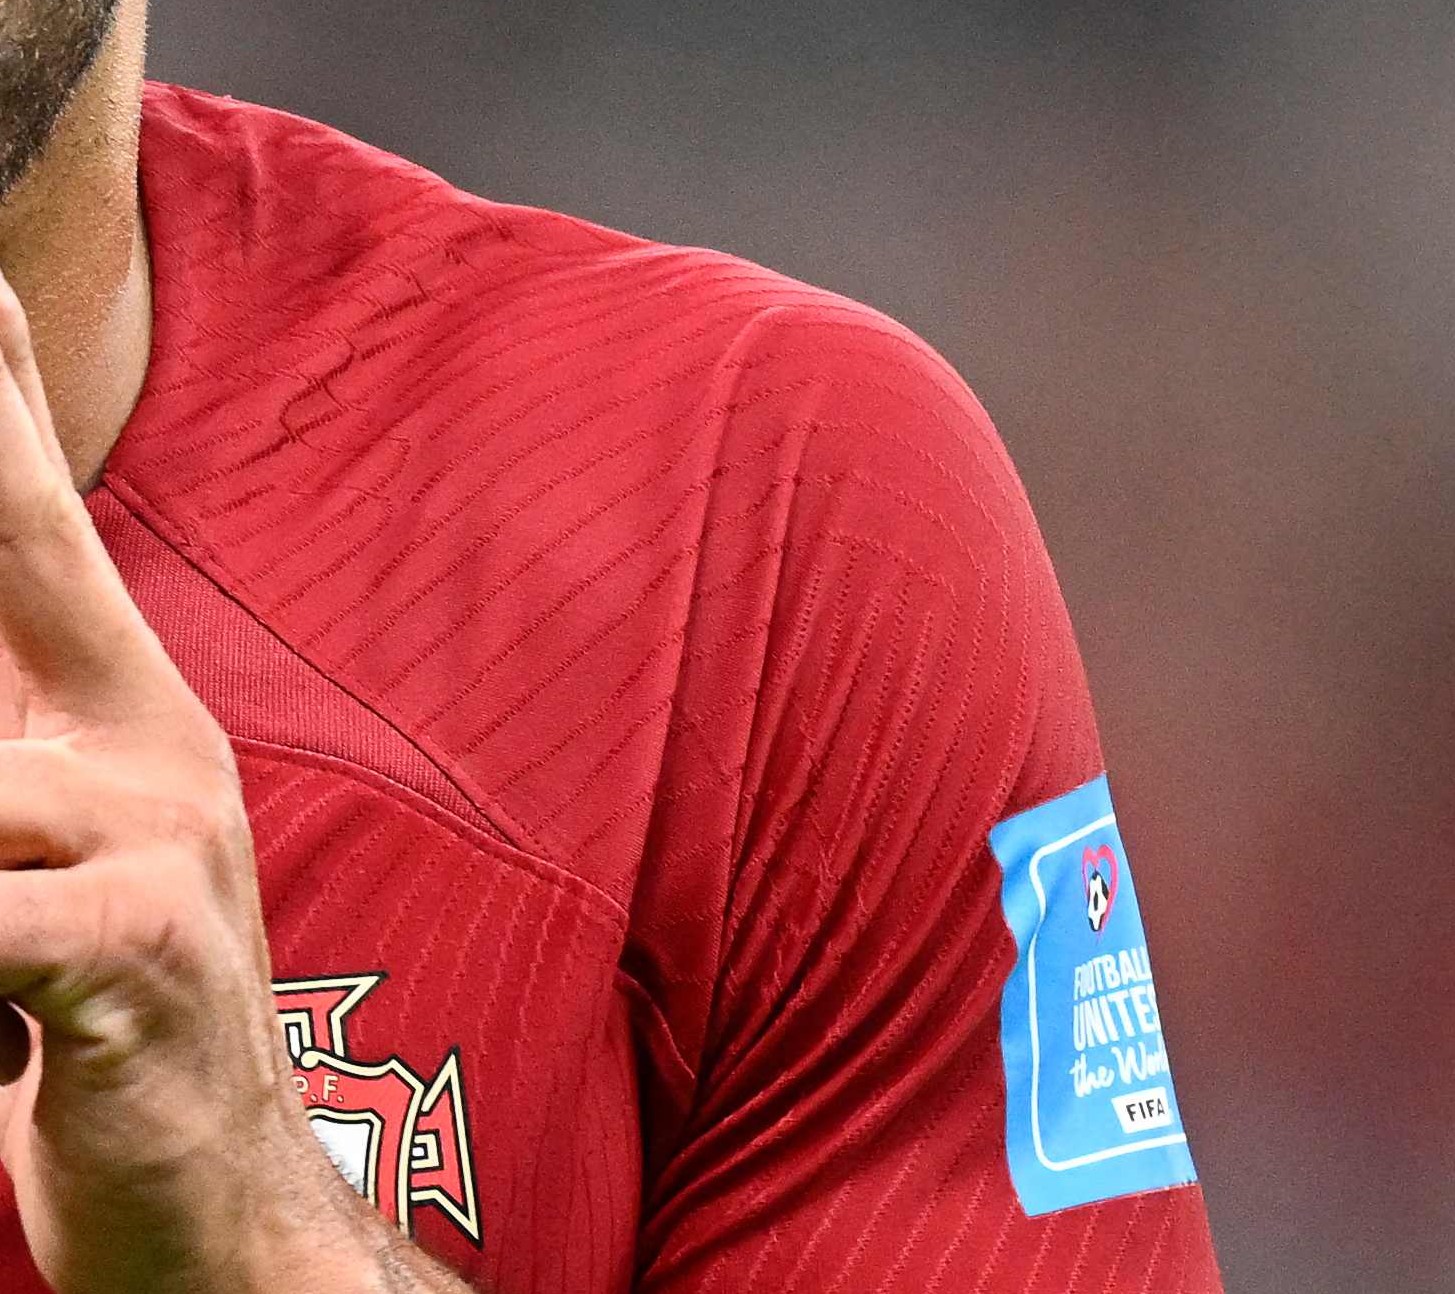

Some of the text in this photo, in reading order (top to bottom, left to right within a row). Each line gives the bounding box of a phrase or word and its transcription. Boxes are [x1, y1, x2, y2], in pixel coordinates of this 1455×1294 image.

[289, 1074, 345, 1103] P.F.
[1070, 1053, 1115, 1098] the
[1126, 1097, 1165, 1122] FIFA
